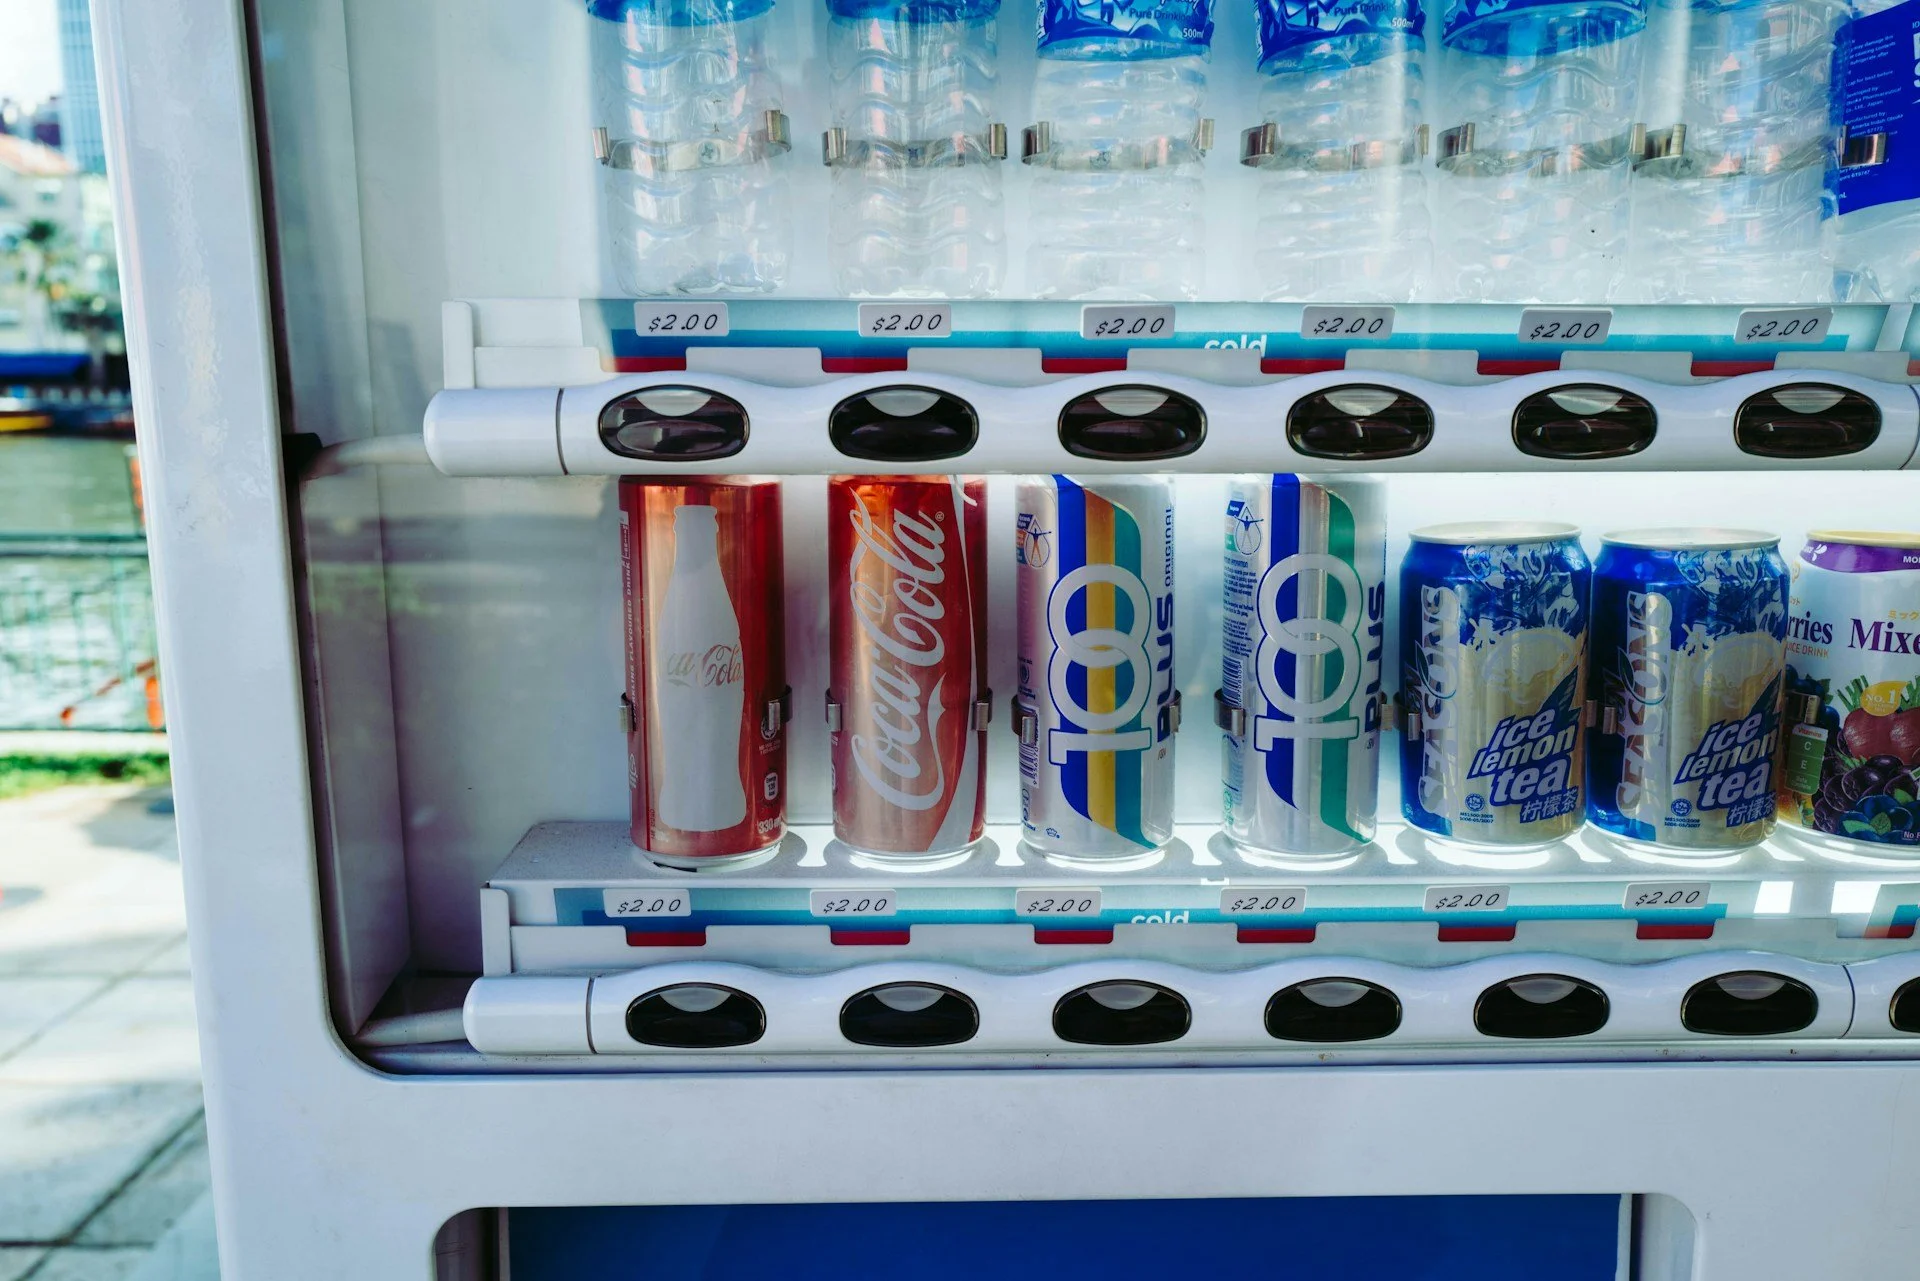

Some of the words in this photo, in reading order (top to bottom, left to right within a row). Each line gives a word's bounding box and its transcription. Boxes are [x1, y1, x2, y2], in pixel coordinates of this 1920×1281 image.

[1129, 8, 1152, 20] Pure
[1334, 5, 1358, 17] Pure
[1391, 17, 1415, 29] 500ml
[649, 314, 718, 332] $2.00
[872, 314, 942, 333] $2.00
[1096, 317, 1165, 337] $2.00
[1313, 317, 1384, 335] $2.00
[1530, 322, 1600, 340] $2.00
[1746, 318, 1819, 340] $2.00
[1203, 334, 1268, 358] cold
[1164, 508, 1173, 586] ORIGINAL
[1903, 555, 1920, 564] MO
[1888, 609, 1920, 621] ミック
[1786, 611, 1833, 645] rries
[1847, 617, 1920, 655] Mixe
[1364, 581, 1386, 733] PLUS
[1156, 592, 1176, 743] PLUS
[1489, 709, 1556, 752] ice
[1700, 712, 1762, 757] ice
[1472, 723, 1576, 777] lemon
[1679, 728, 1777, 781] lemon
[1804, 741, 1812, 751] C
[1801, 760, 1808, 769] E
[1492, 758, 1569, 803] tea
[1701, 762, 1771, 808] tea
[617, 899, 682, 914] $2.00
[823, 899, 887, 914] $2.00
[1027, 899, 1092, 914] $2.00
[1231, 896, 1296, 912] $2.00
[1436, 893, 1500, 911] $2.00
[1635, 890, 1700, 907] $2.00
[1131, 910, 1190, 925] cold
